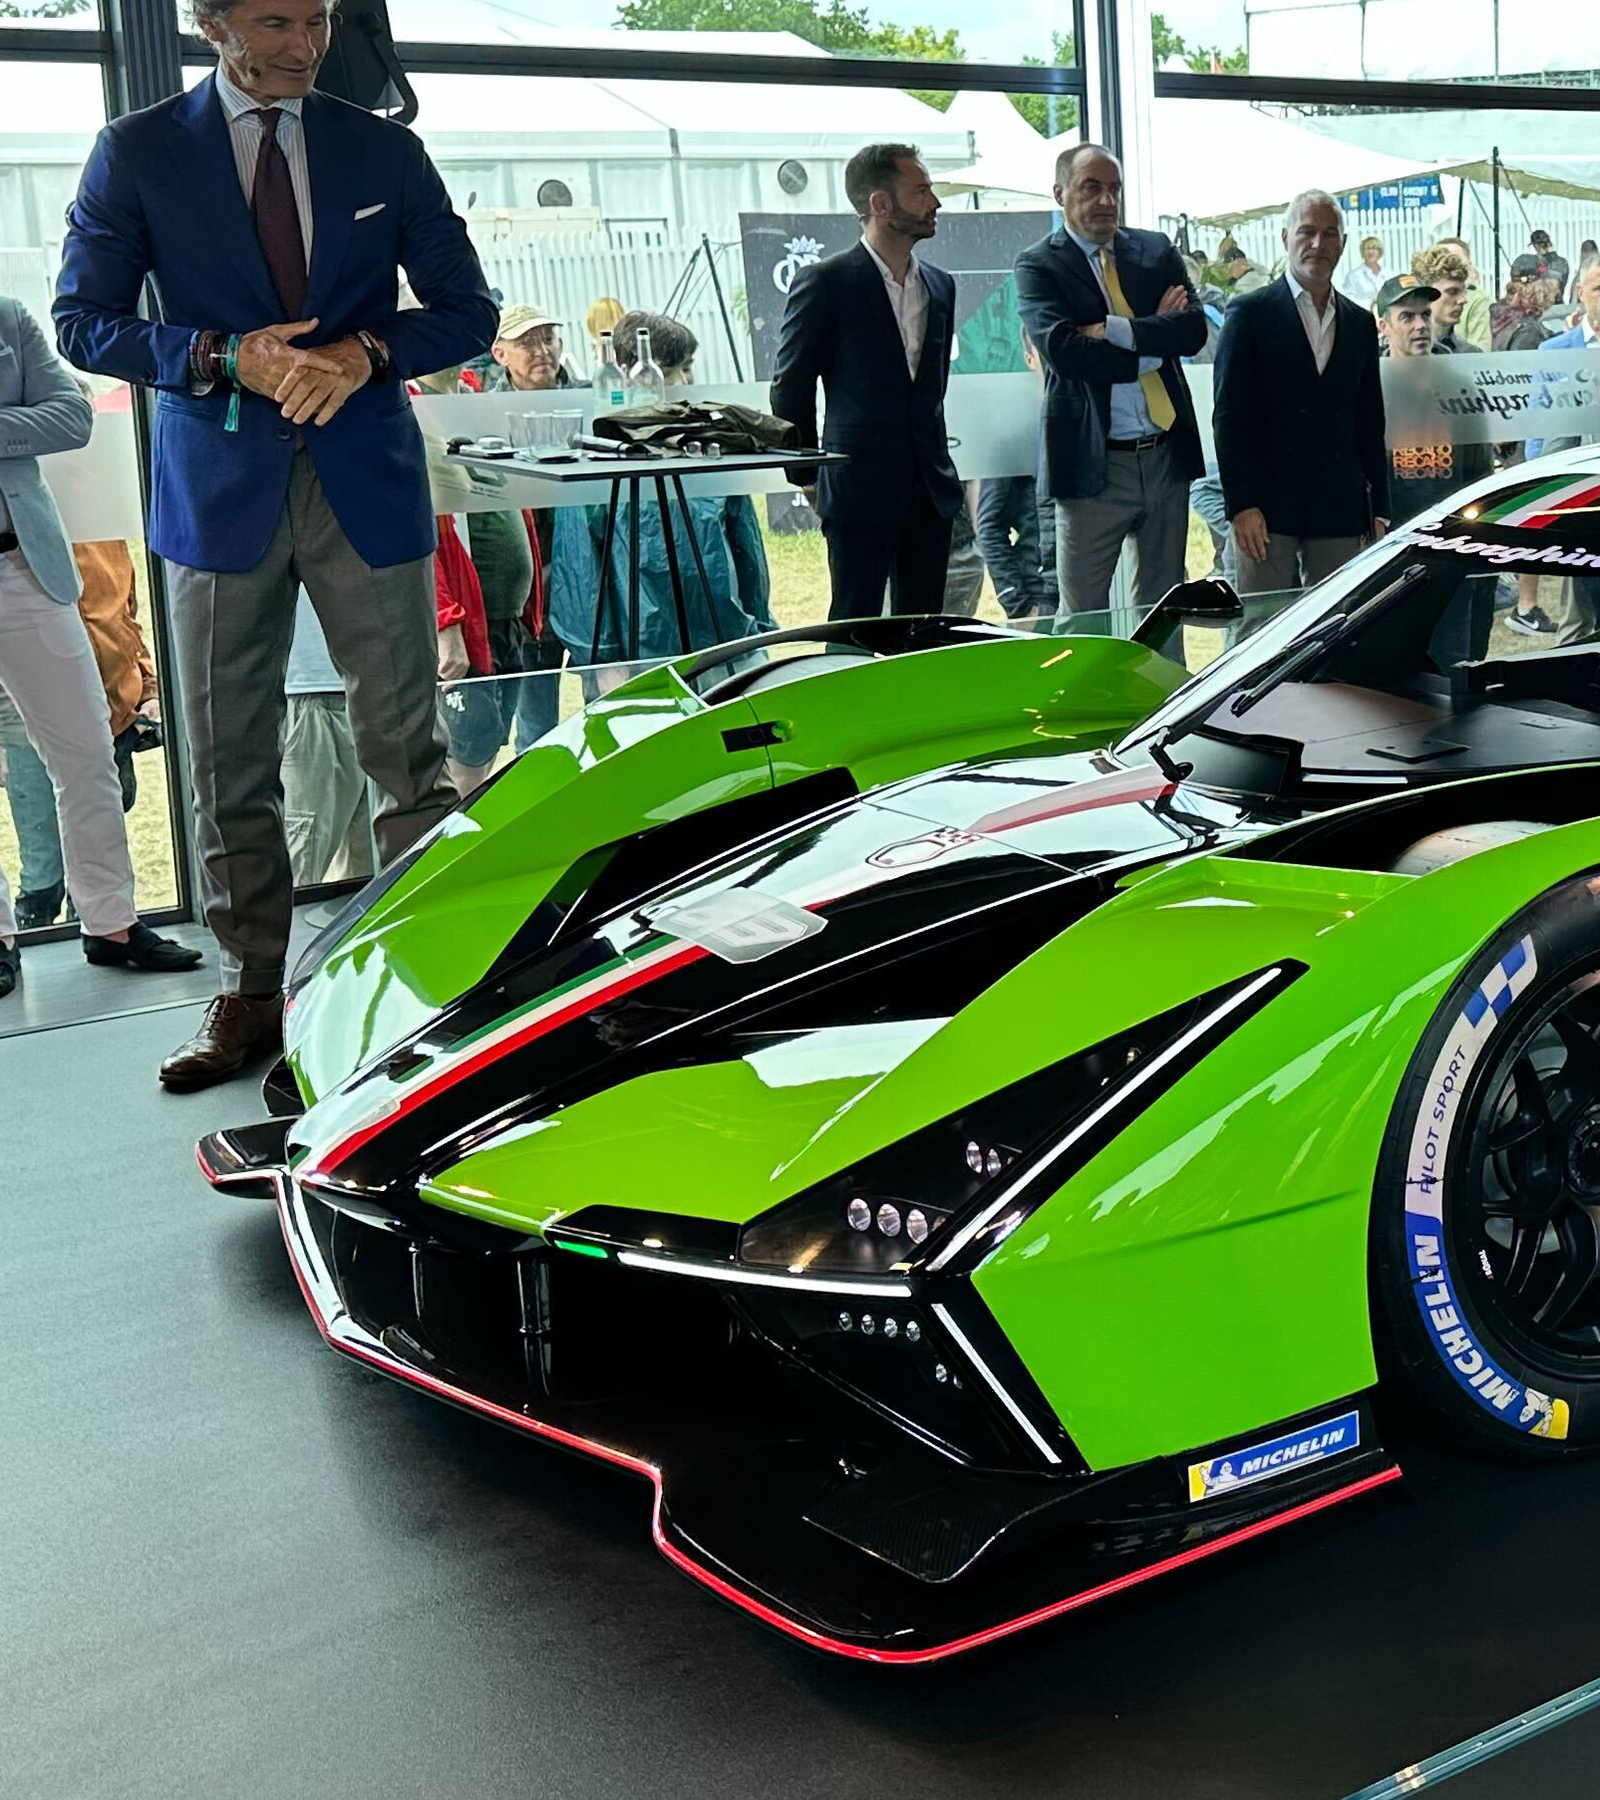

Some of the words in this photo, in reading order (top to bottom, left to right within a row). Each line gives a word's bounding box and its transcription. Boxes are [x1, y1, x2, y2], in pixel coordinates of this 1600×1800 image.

[1393, 456, 1454, 468] RECARO
[1394, 467, 1453, 480] RECARO
[1419, 1126, 1440, 1195] PILOT
[1432, 1044, 1467, 1123] SPORT
[1413, 1234, 1521, 1412] MICHELIN
[1240, 1427, 1346, 1476] MICHELIN
